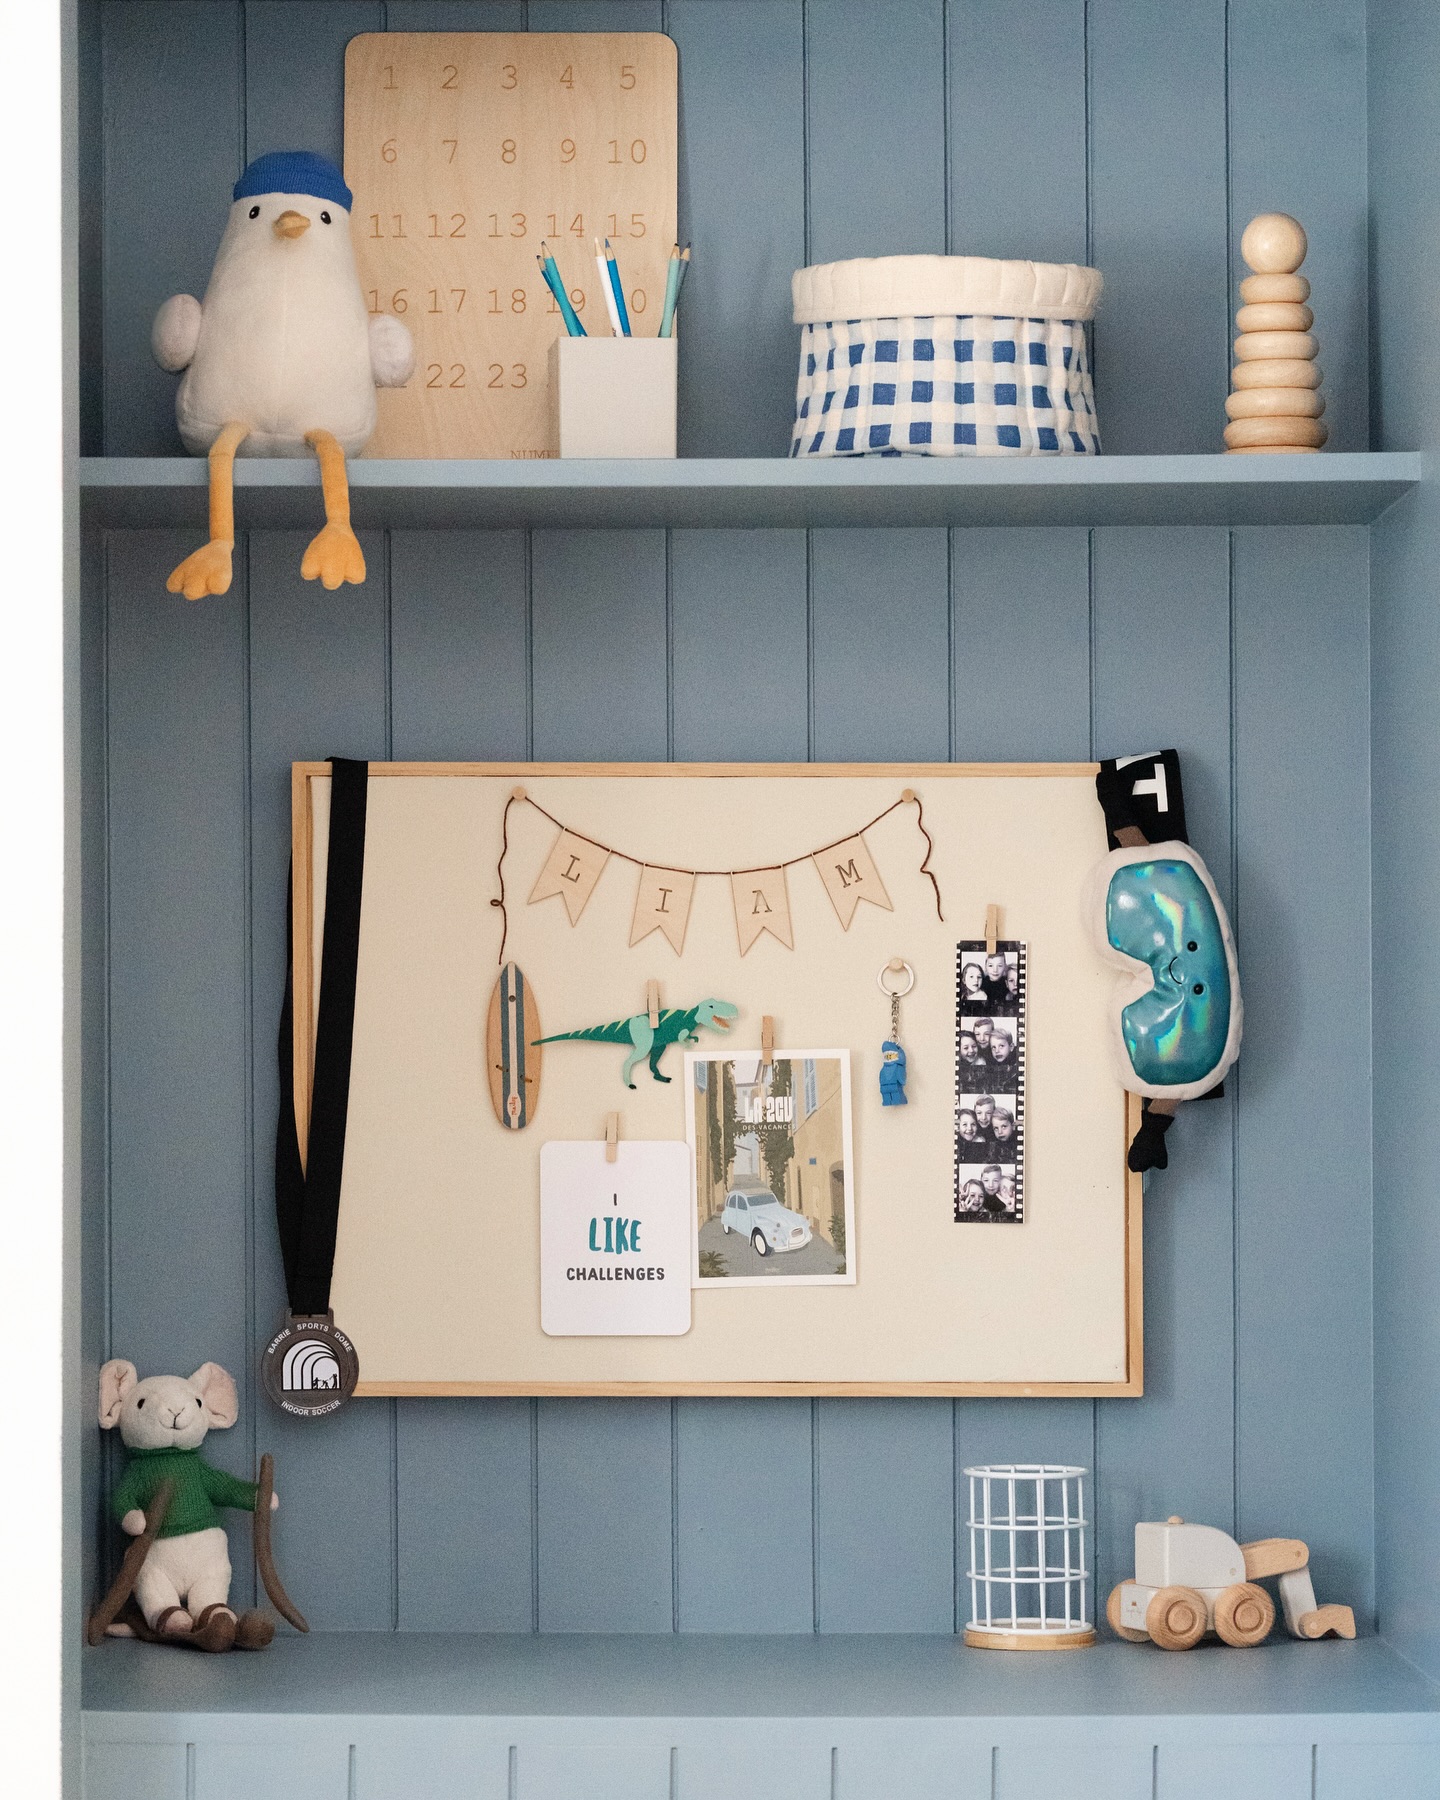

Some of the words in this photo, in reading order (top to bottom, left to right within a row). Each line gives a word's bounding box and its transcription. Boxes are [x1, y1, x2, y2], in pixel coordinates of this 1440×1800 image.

[383, 65, 399, 90] 1
[441, 64, 459, 90] 2
[501, 64, 518, 90] 3
[559, 64, 575, 90] 4
[619, 65, 636, 90] 5
[381, 138, 398, 164] 6
[442, 139, 459, 164] 7
[501, 138, 517, 164] 8
[560, 138, 577, 164] 9
[607, 139, 647, 164] 10
[369, 213, 408, 239] 11
[427, 213, 467, 239] 12
[488, 212, 528, 238] 13
[546, 213, 585, 238] 14
[607, 213, 647, 238] 15
[367, 288, 408, 314] 16
[427, 288, 467, 314] 17
[487, 288, 527, 314] 18
[545, 288, 586, 314] 19
[426, 363, 467, 389] 22
[487, 363, 528, 389] 23
[744, 1096, 762, 1123] LA
[613, 1192, 618, 1207] I
[588, 1216, 642, 1255] LIKE
[566, 1267, 665, 1281] CHALLENGES
[268, 1329, 291, 1354] BARRIE
[297, 1322, 329, 1332] SPORTS
[334, 1331, 352, 1352] DOME
[281, 1400, 309, 1415] INDOOR
[312, 1399, 341, 1415] SOCCER
